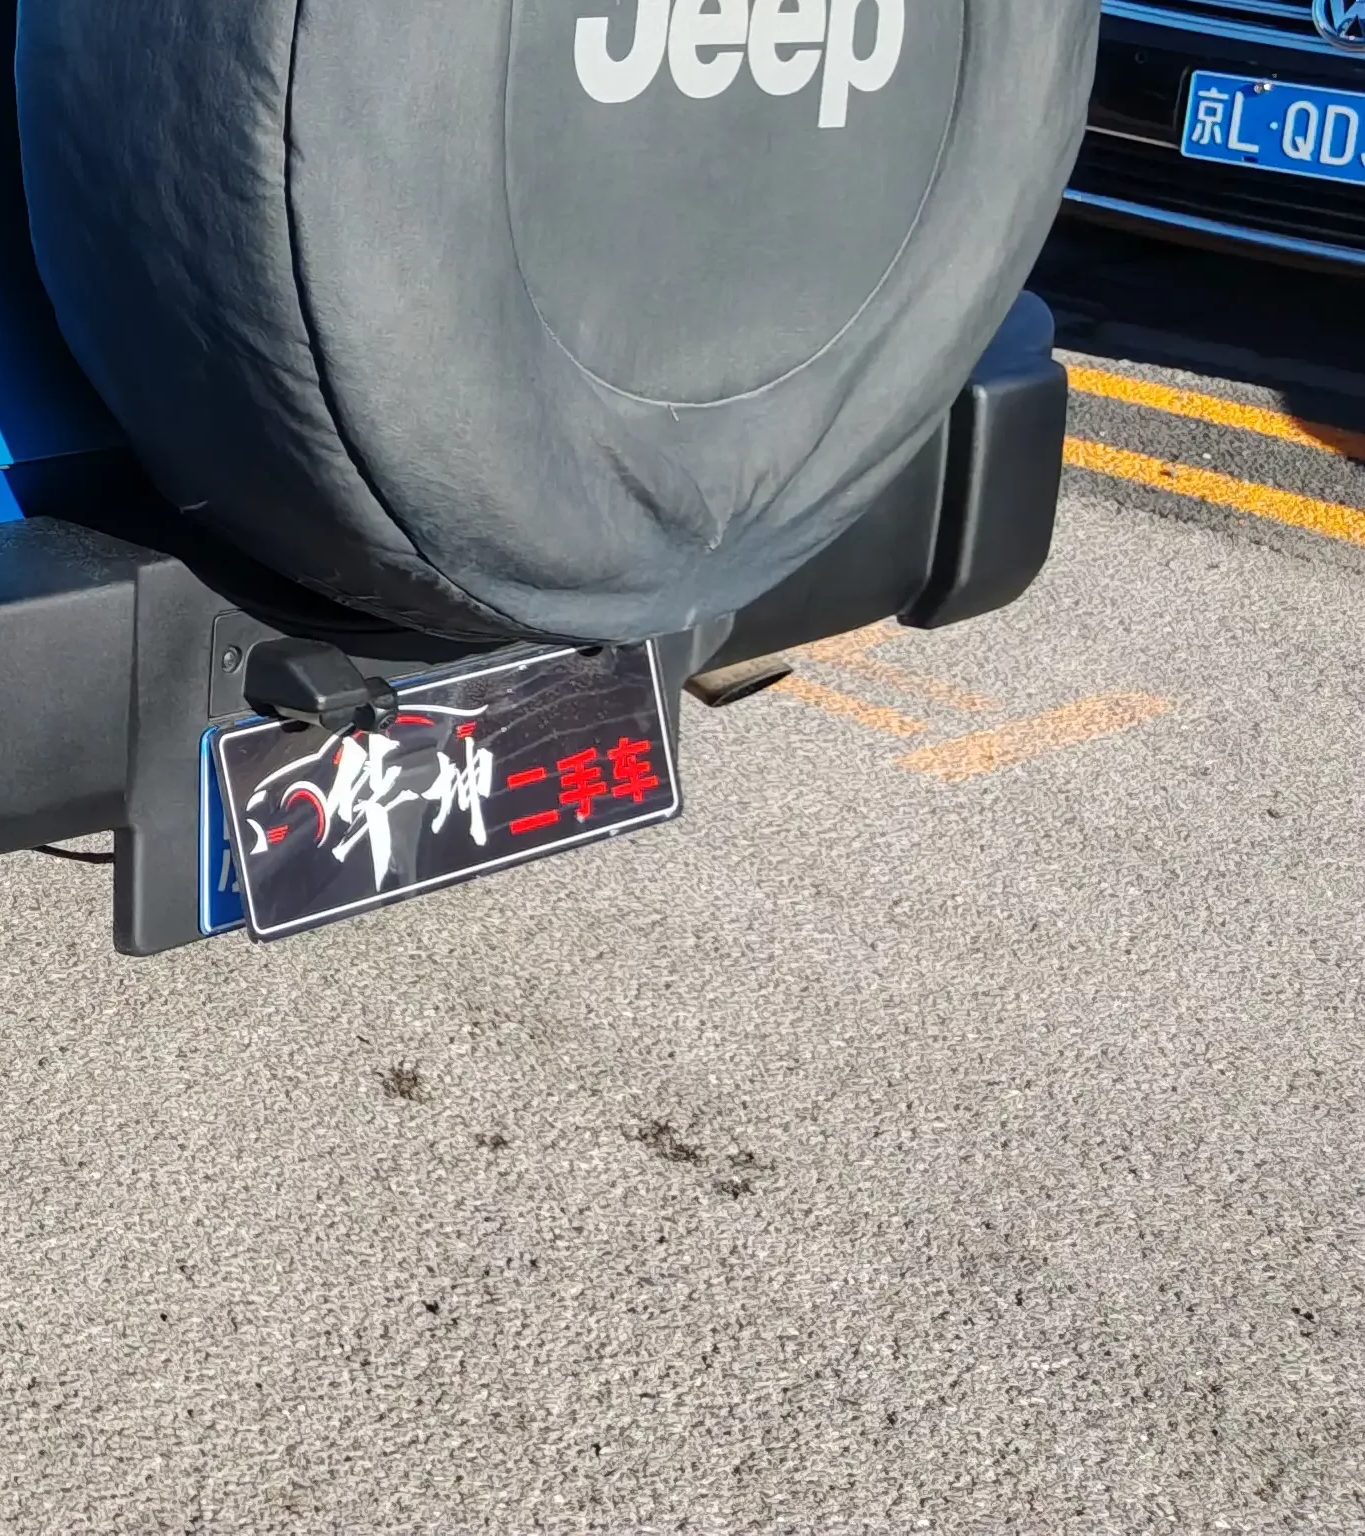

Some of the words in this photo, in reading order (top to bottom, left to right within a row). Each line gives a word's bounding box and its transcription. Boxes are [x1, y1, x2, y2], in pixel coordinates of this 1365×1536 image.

[1191, 87, 1365, 167] 京L·QD
[506, 737, 659, 834] 二手车
